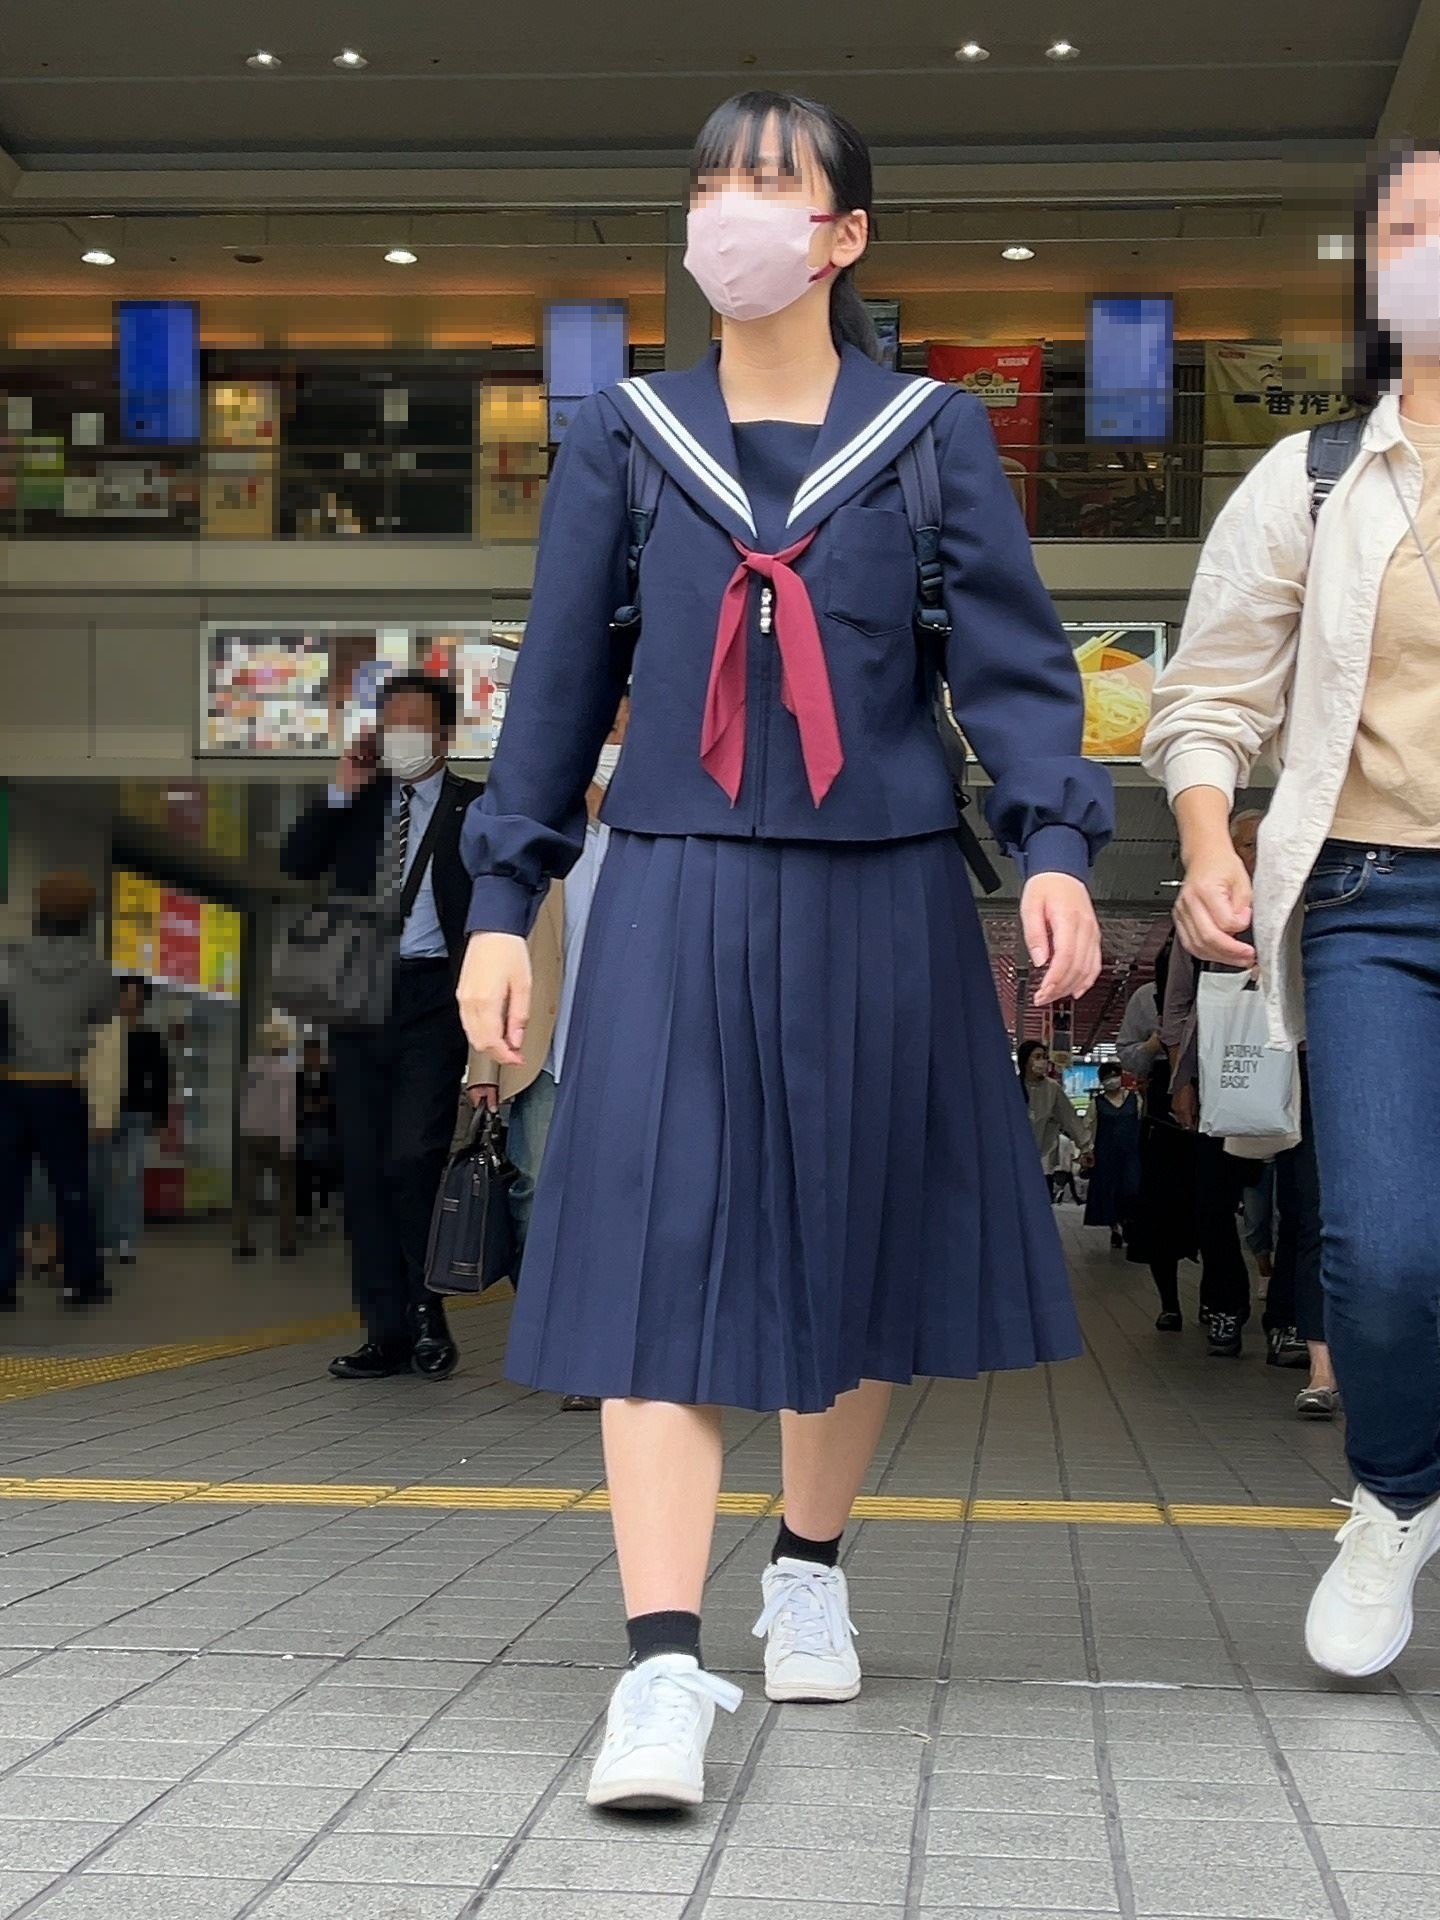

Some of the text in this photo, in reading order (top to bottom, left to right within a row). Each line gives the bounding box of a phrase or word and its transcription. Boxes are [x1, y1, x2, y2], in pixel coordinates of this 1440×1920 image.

[1223, 1044, 1265, 1058] NATURAL
[1222, 1060, 1258, 1073] BEAUTY
[1220, 1075, 1250, 1089] BASIC
